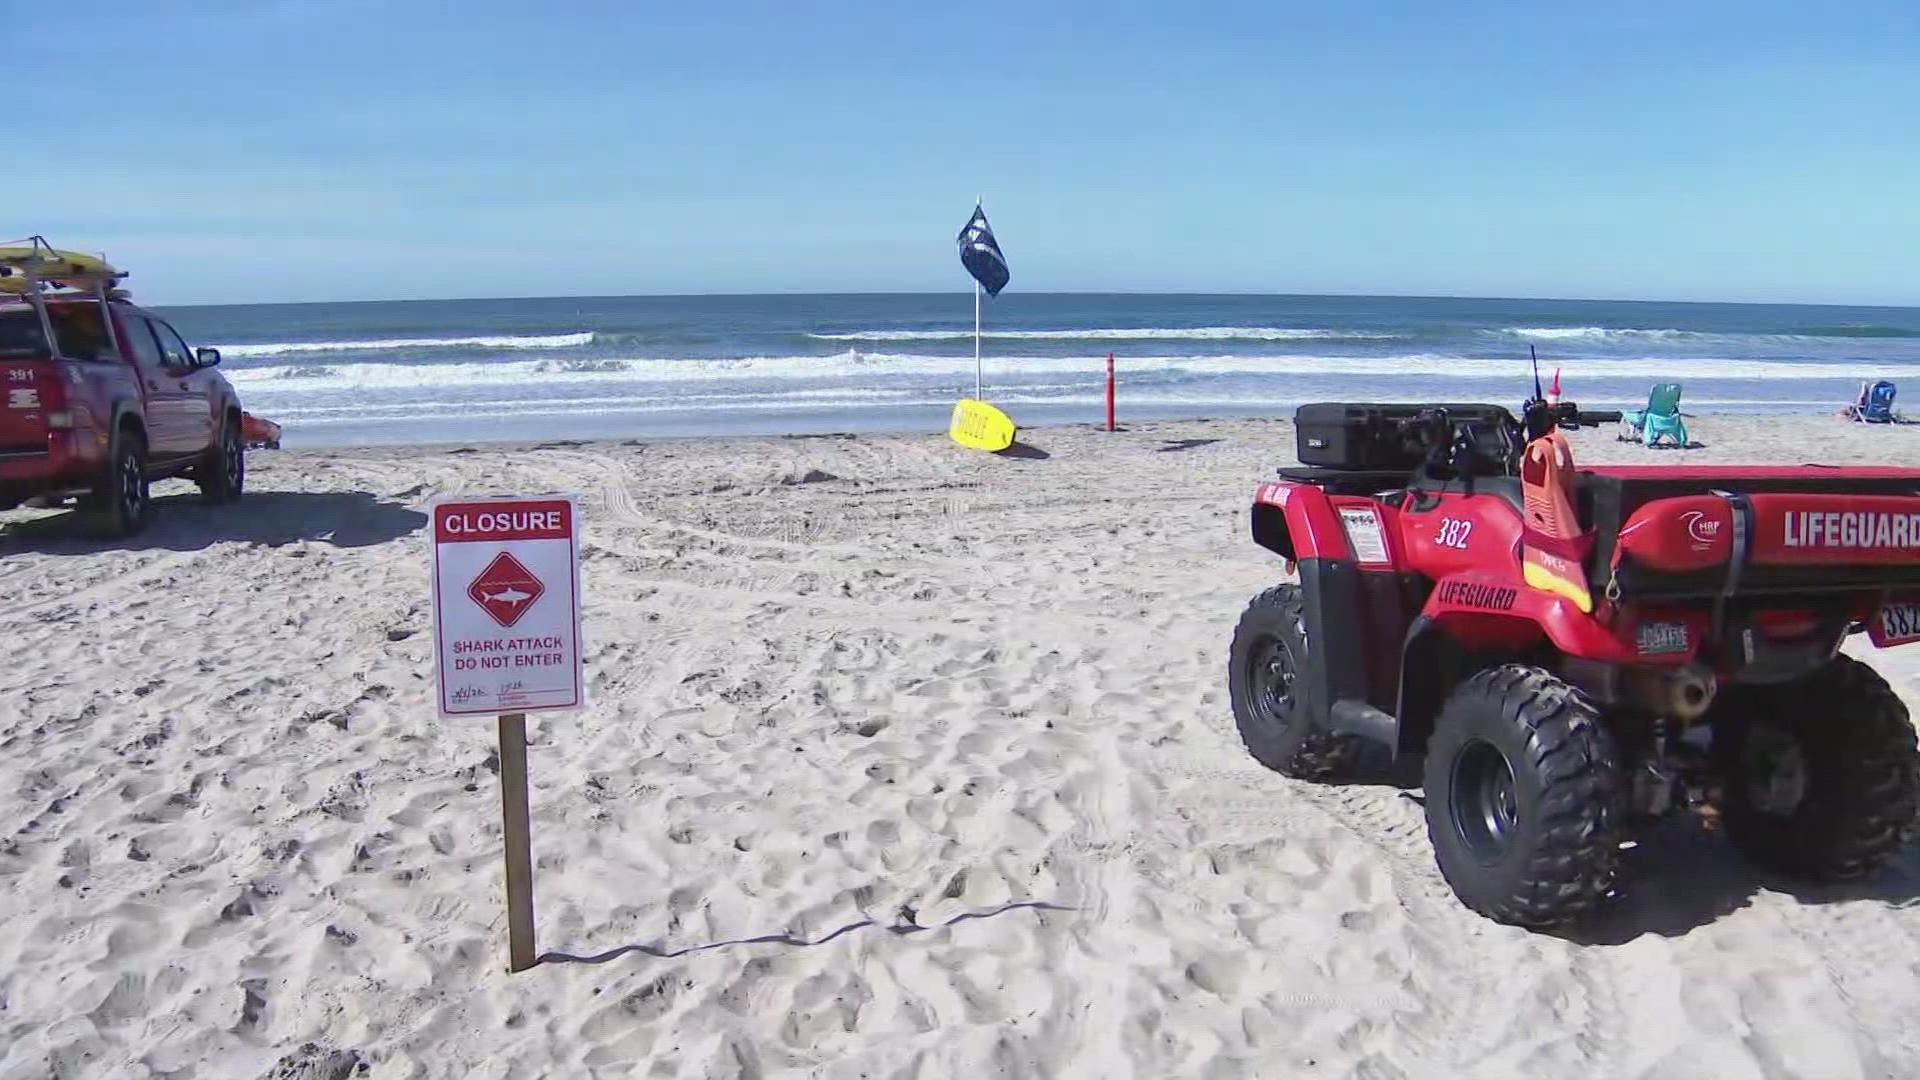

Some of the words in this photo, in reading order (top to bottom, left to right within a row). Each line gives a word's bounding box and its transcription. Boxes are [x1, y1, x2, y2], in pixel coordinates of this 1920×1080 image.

[9, 369, 34, 381] 391
[445, 511, 562, 534] CLOSURE
[1435, 517, 1472, 549] 382
[1438, 581, 1517, 611] LIFEGUARD
[453, 640, 504, 654] SHARK
[507, 637, 563, 650] ATTACK
[455, 658, 477, 670] DO
[481, 655, 510, 669] NOT
[515, 653, 562, 667] ENTER
